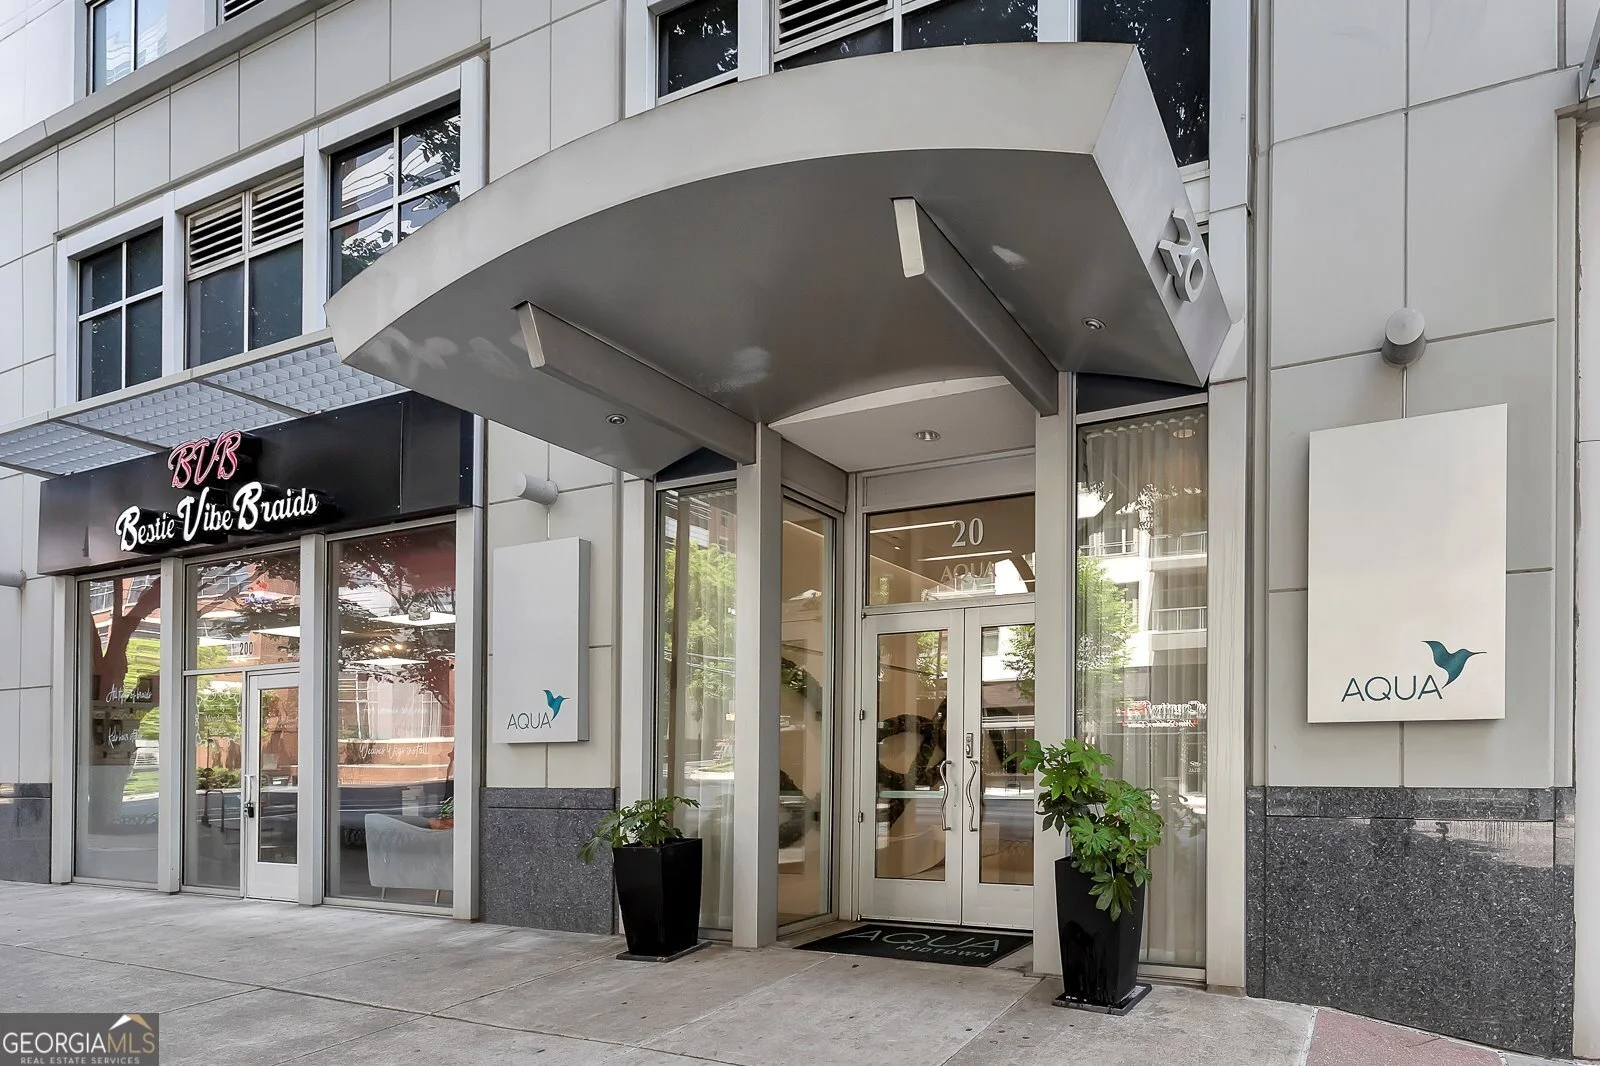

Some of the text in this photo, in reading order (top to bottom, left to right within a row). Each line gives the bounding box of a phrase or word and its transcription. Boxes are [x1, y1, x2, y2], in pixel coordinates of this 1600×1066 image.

[168, 429, 241, 488] BVB
[115, 481, 319, 552] Bestie Vibe Braids
[951, 517, 984, 548] 20
[940, 560, 995, 582] AQUA
[239, 641, 254, 655] 200
[1340, 674, 1443, 702] AQUA
[506, 711, 552, 730] AQUA
[839, 929, 999, 952] AQUA
[895, 945, 992, 959] MIDTOWN
